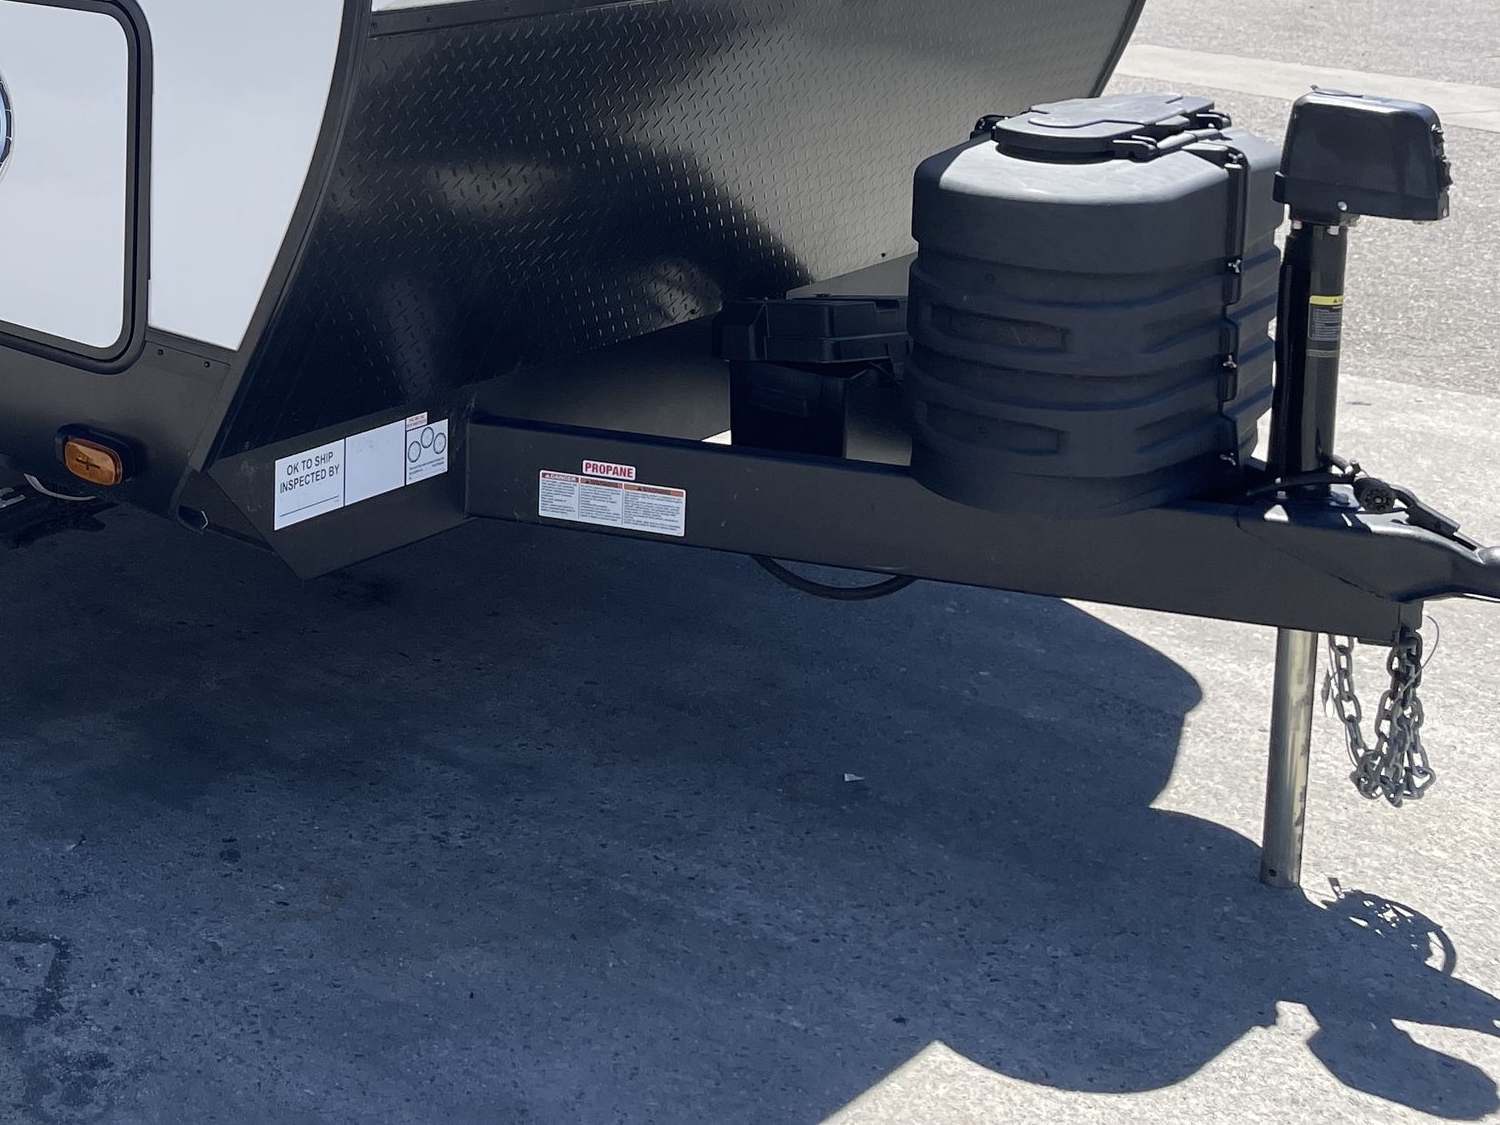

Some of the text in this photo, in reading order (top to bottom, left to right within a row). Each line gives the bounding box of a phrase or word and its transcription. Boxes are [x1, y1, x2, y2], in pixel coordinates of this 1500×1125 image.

[287, 451, 334, 475] OK TO SHIP
[585, 462, 634, 478] PROPANE
[279, 464, 340, 493] INSPECTED BY
